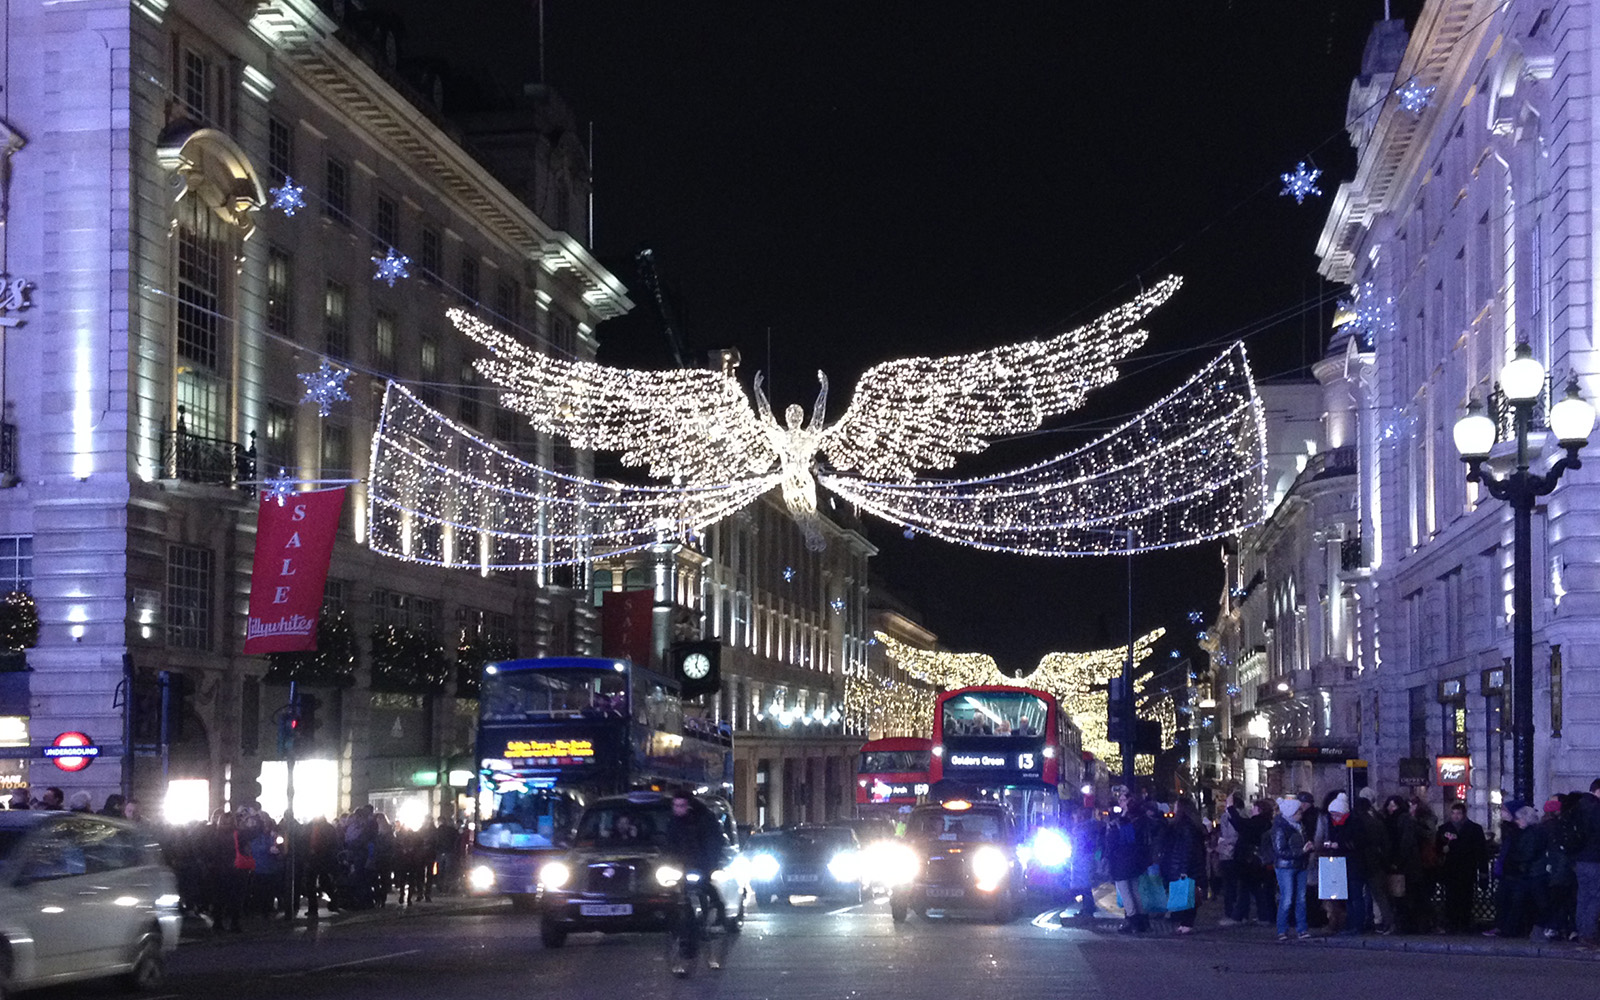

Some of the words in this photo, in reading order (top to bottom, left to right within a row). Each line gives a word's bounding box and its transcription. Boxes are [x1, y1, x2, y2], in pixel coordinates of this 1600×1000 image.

[272, 504, 306, 605] SALE
[981, 755, 1005, 766] Green
[1018, 753, 1034, 770] 13
[1441, 762, 1465, 773] Pizza
[1444, 771, 1460, 779] Hut
